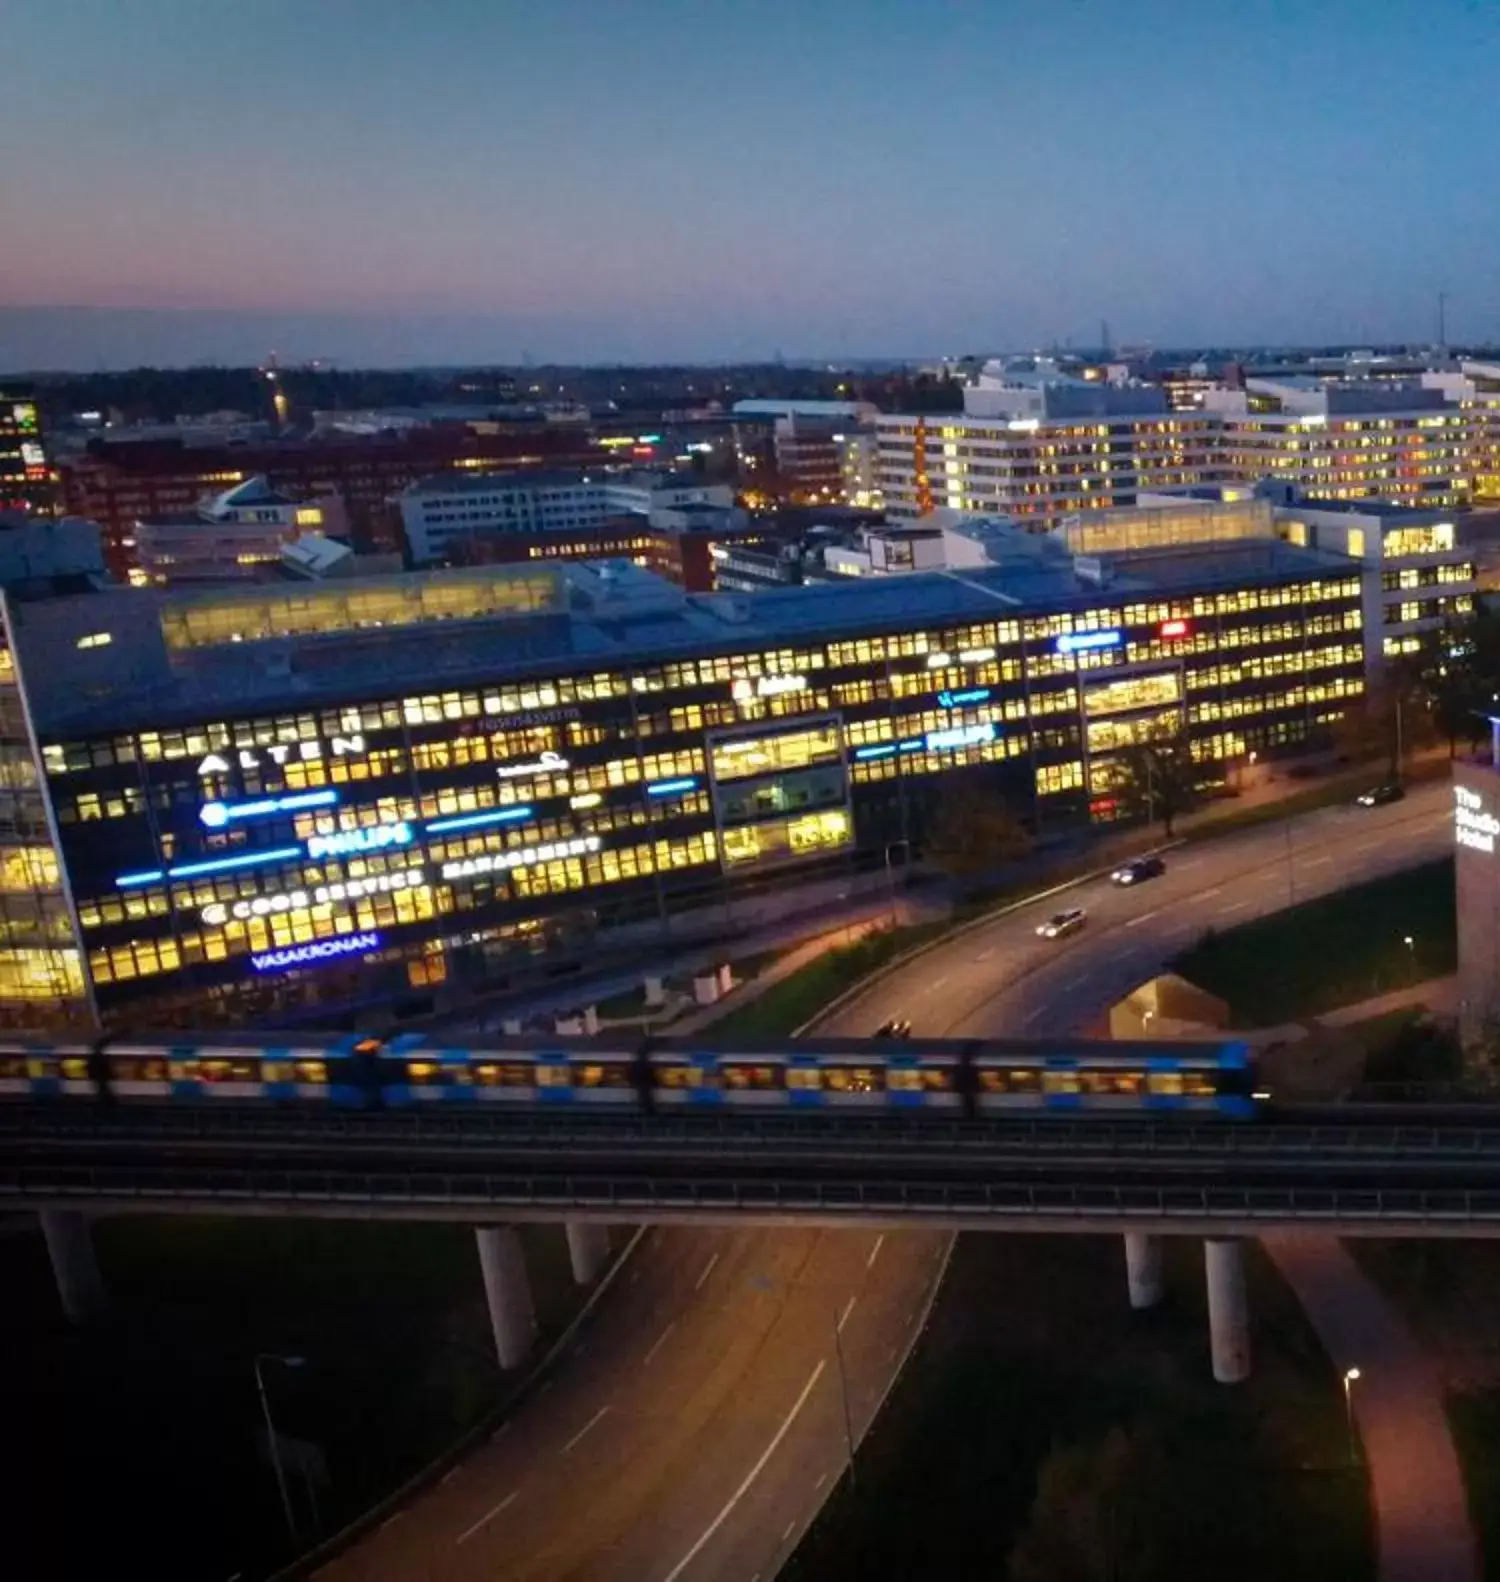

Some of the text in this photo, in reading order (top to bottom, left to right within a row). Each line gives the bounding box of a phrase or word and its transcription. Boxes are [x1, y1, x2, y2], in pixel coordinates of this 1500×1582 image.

[198, 735, 365, 775] ALTEN
[1453, 785, 1482, 809] The
[1456, 806, 1500, 836] Studio
[307, 822, 412, 859] PHILIPS
[1456, 825, 1494, 854] Hotel
[251, 933, 378, 969] VASAKRONAN
